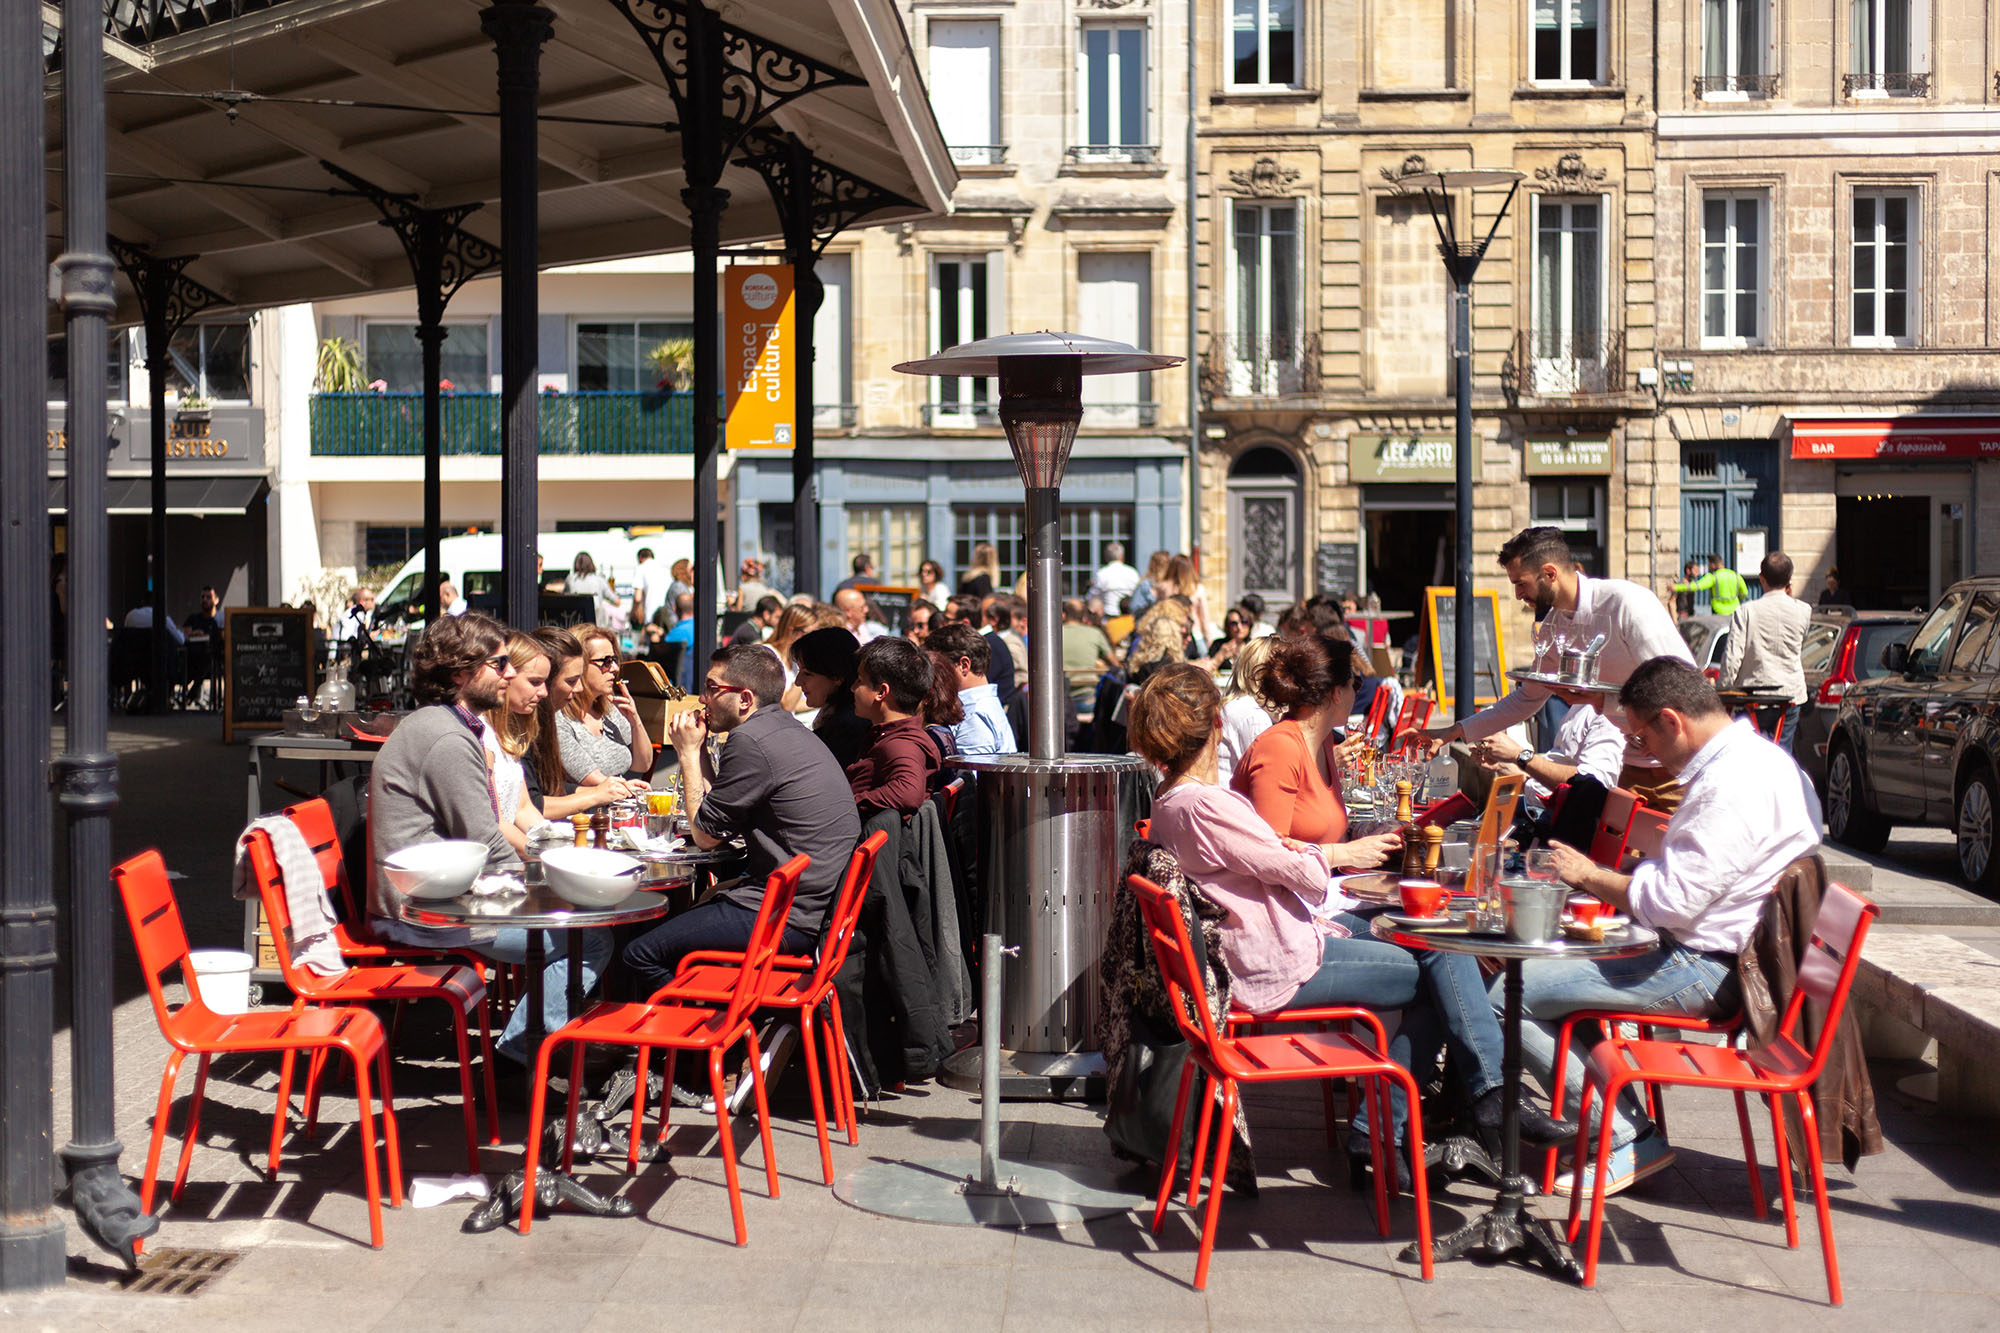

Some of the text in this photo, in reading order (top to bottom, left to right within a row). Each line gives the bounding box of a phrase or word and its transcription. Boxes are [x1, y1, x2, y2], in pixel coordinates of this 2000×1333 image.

[738, 322, 763, 393] Espace
[760, 323, 781, 402] culturel
[169, 422, 211, 439] PUB
[165, 439, 229, 457] ISTRO
[1812, 442, 1835, 454] BAR
[1875, 440, 1893, 453] La
